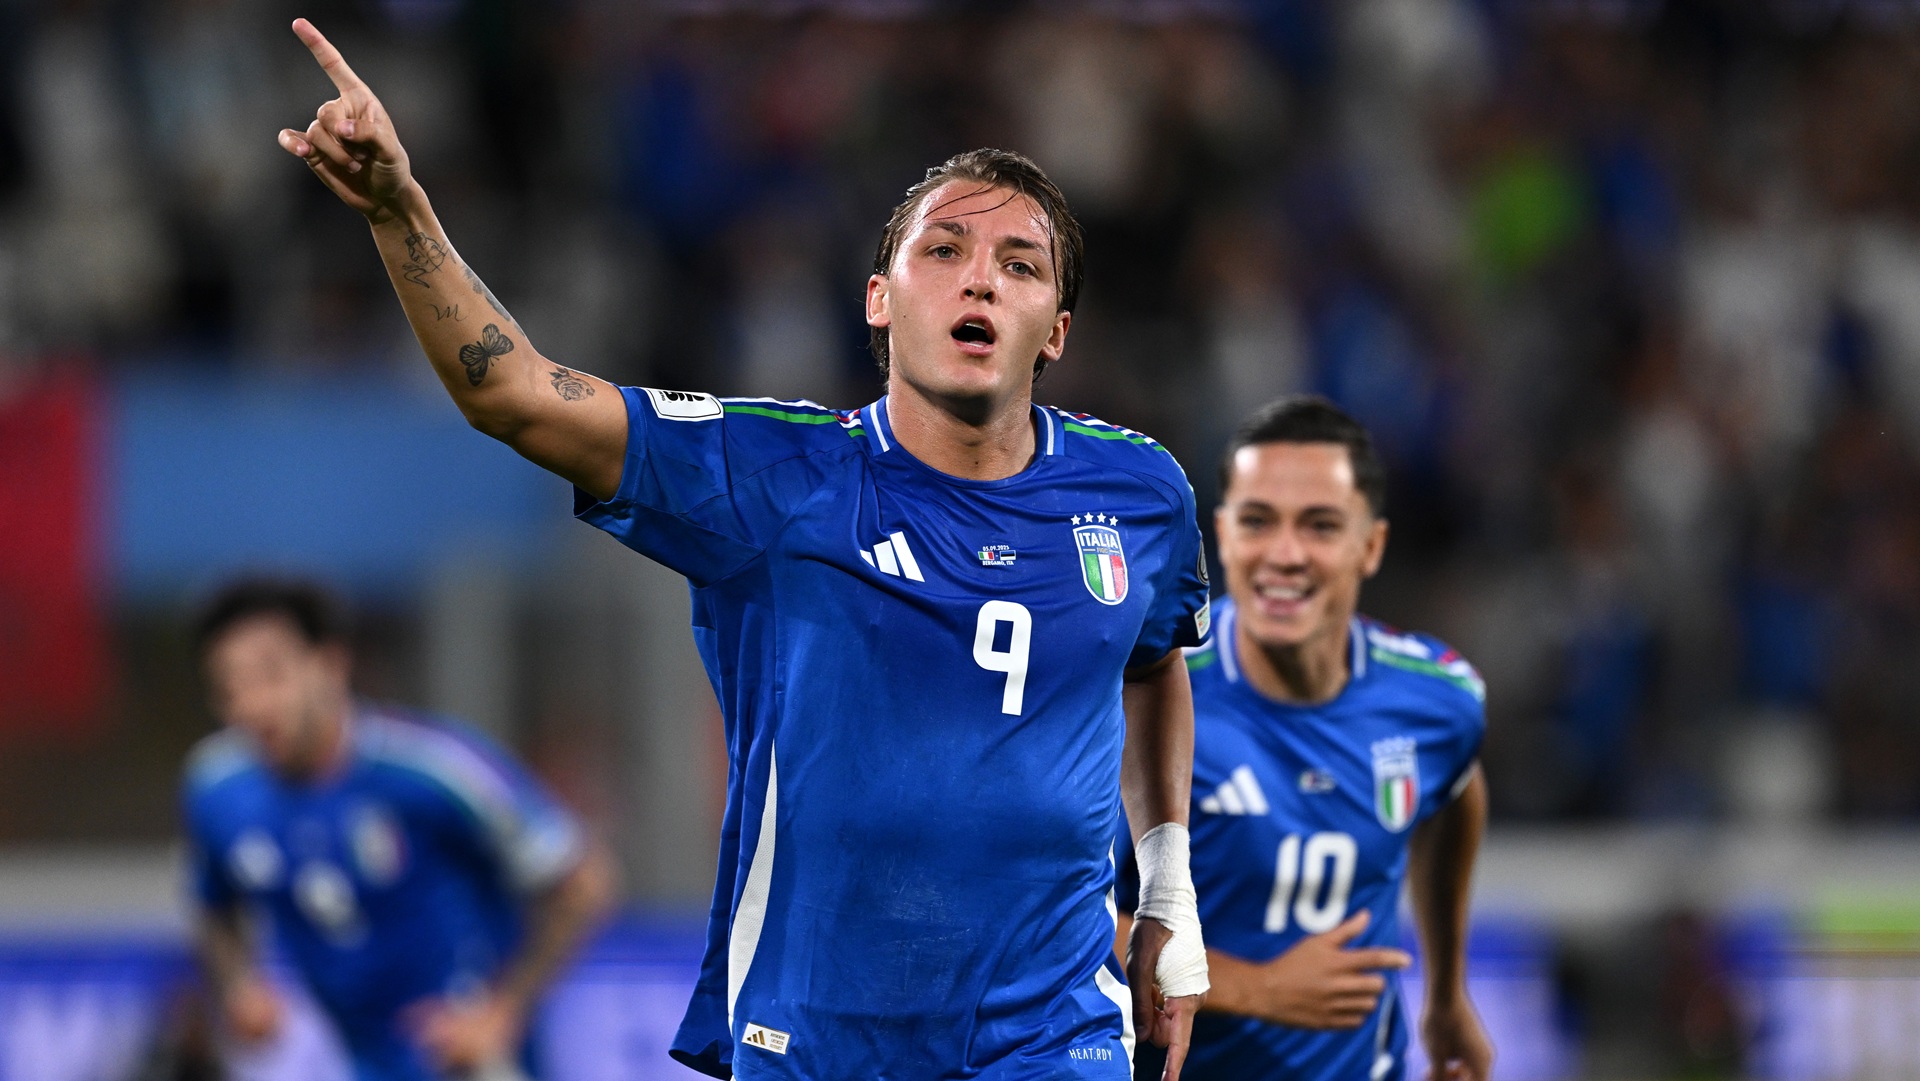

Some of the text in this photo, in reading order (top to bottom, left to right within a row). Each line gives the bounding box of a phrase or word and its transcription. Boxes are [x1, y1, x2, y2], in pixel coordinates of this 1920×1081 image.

[1078, 532, 1119, 549] ITALIA
[973, 600, 1032, 716] 9
[1264, 832, 1358, 934] 10
[1068, 1048, 1112, 1061] HEAT.RDY
